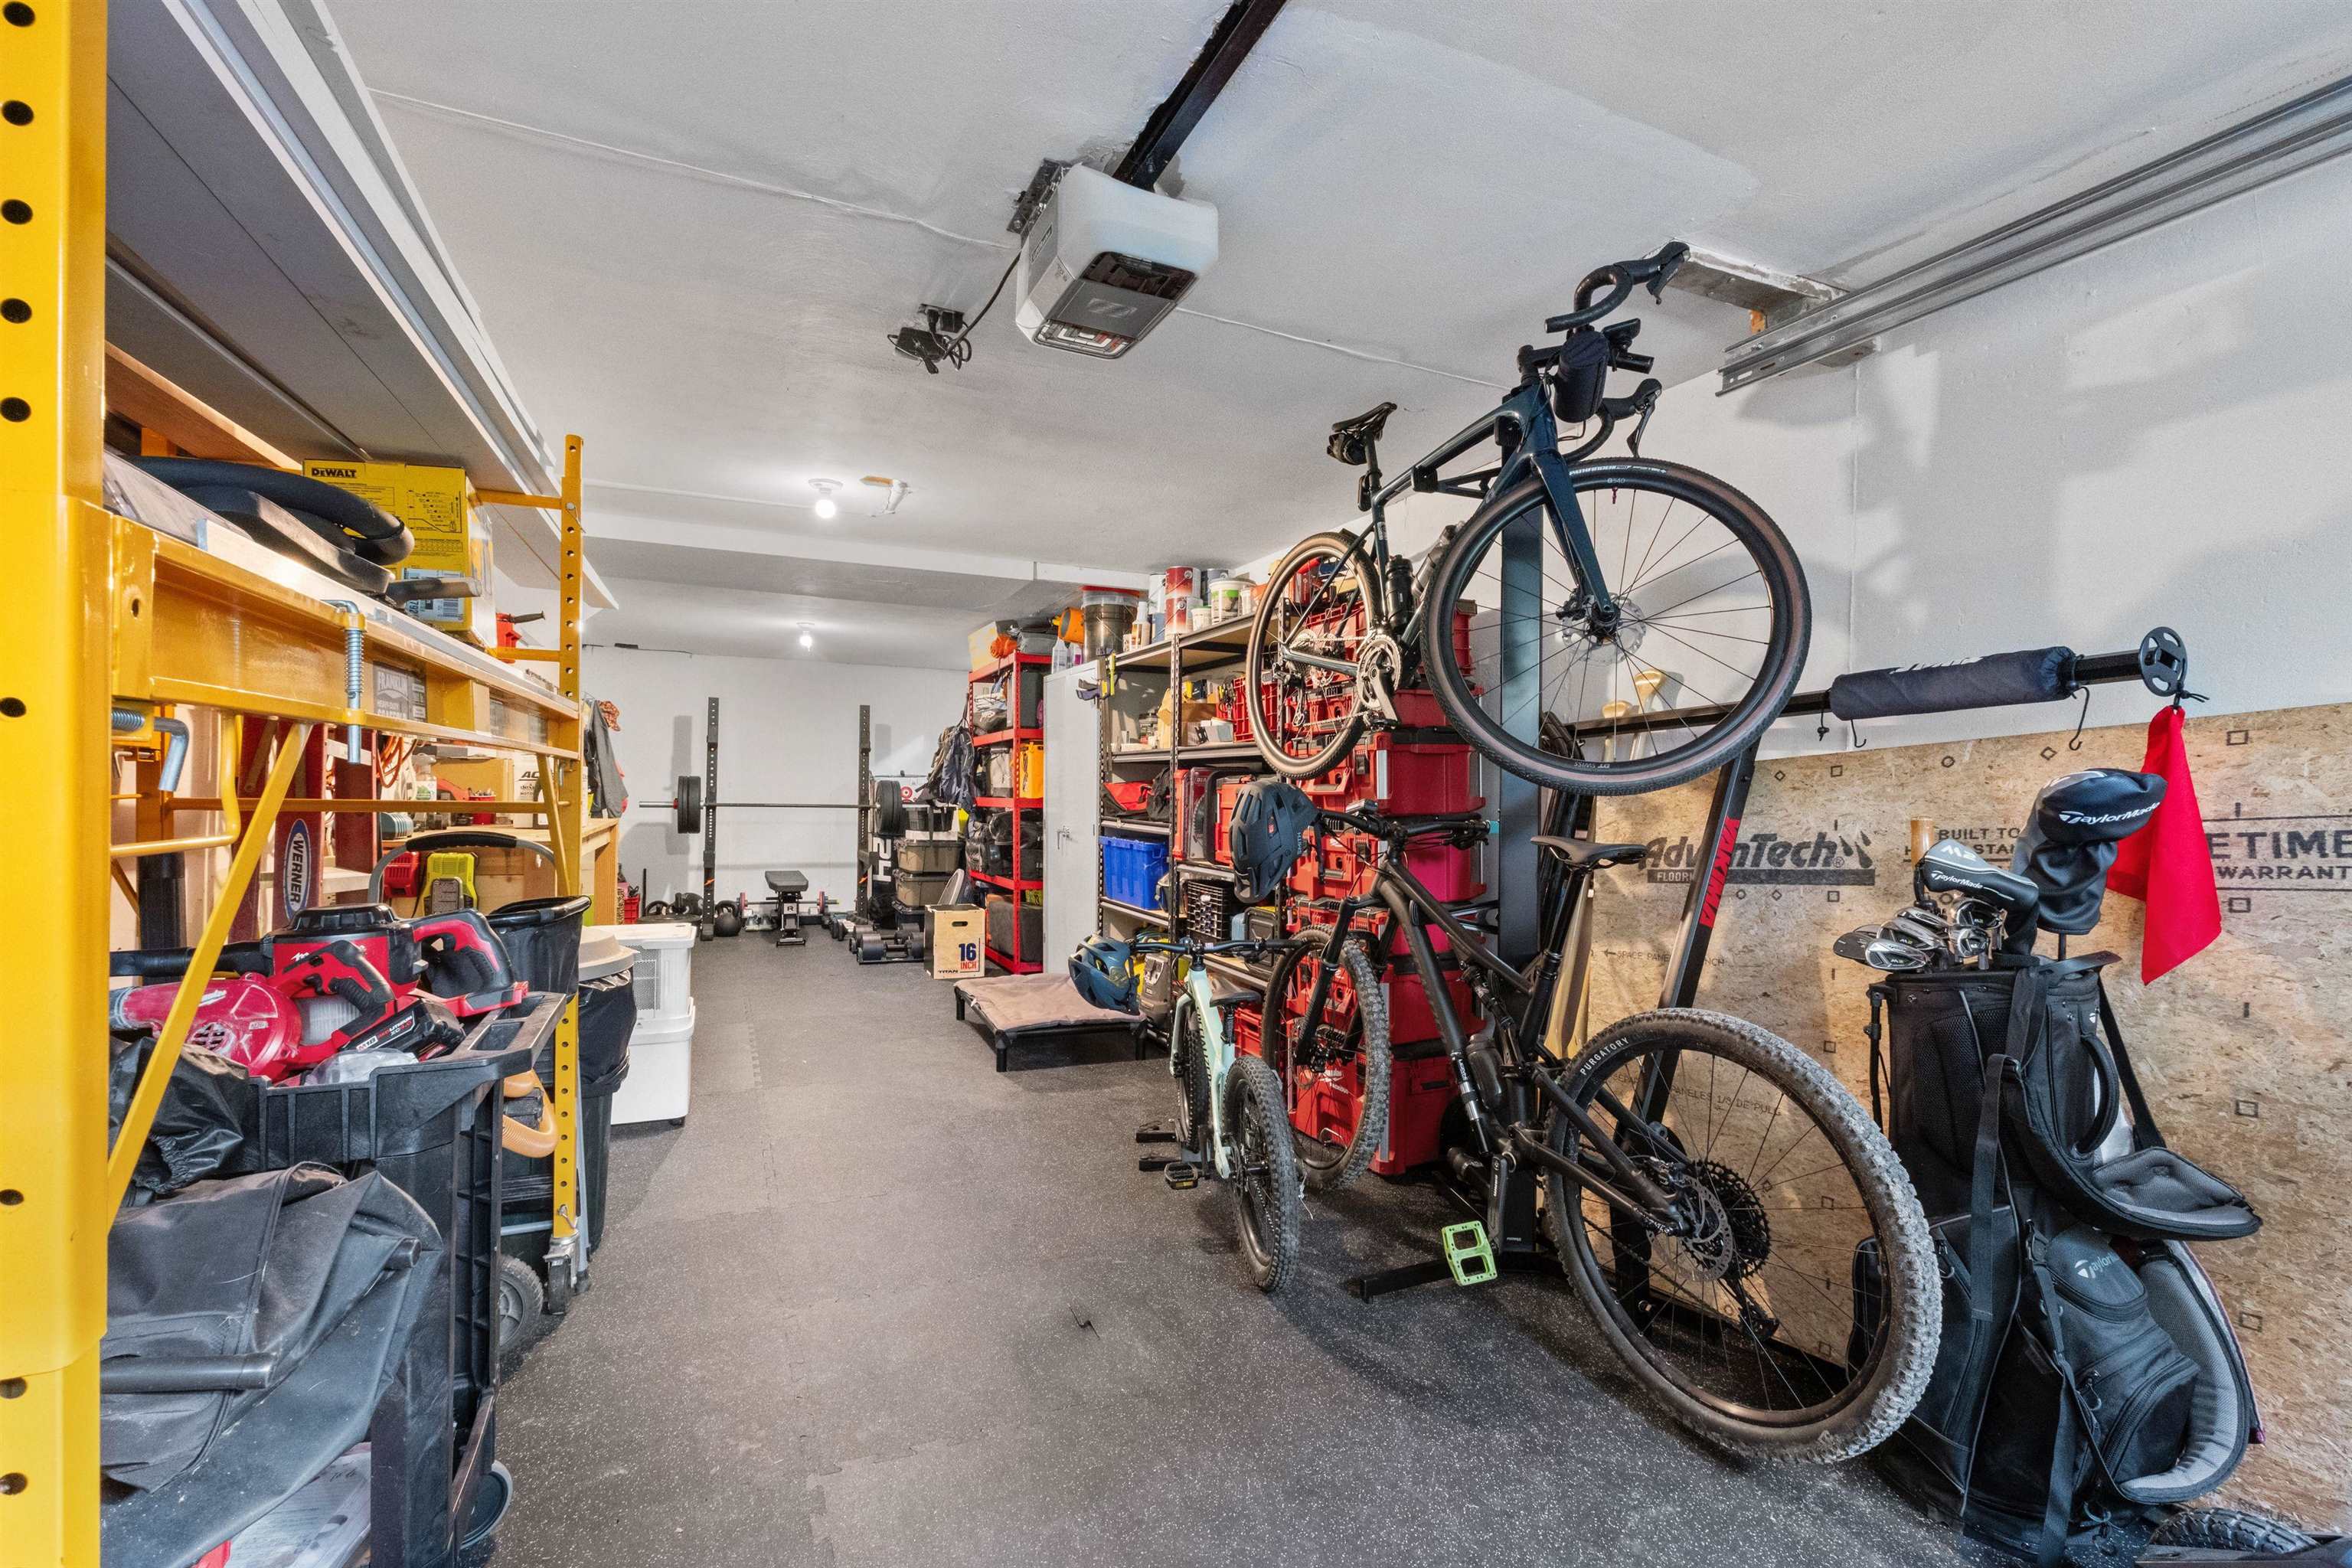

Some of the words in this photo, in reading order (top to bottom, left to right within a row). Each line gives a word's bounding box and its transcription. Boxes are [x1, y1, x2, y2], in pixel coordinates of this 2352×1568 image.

[312, 468, 357, 478] DEWALT
[2058, 802, 2161, 825] TaylorMade
[1938, 828, 1989, 841] BUILT
[1996, 828, 2020, 839] TO
[1638, 831, 1838, 871] AdvnTech
[1941, 844, 1978, 862] M2
[2205, 830, 2352, 859] ETIME
[290, 839, 304, 904] WERNER
[1657, 873, 1694, 881] FLOOR
[1699, 815, 1740, 928] YAKIMA
[1930, 870, 1984, 890] TaylorMade
[2216, 866, 2352, 880] WARRANT
[959, 942, 976, 961] 16
[1647, 952, 1672, 962] PANE
[1579, 1037, 1630, 1076] PURGATORY
